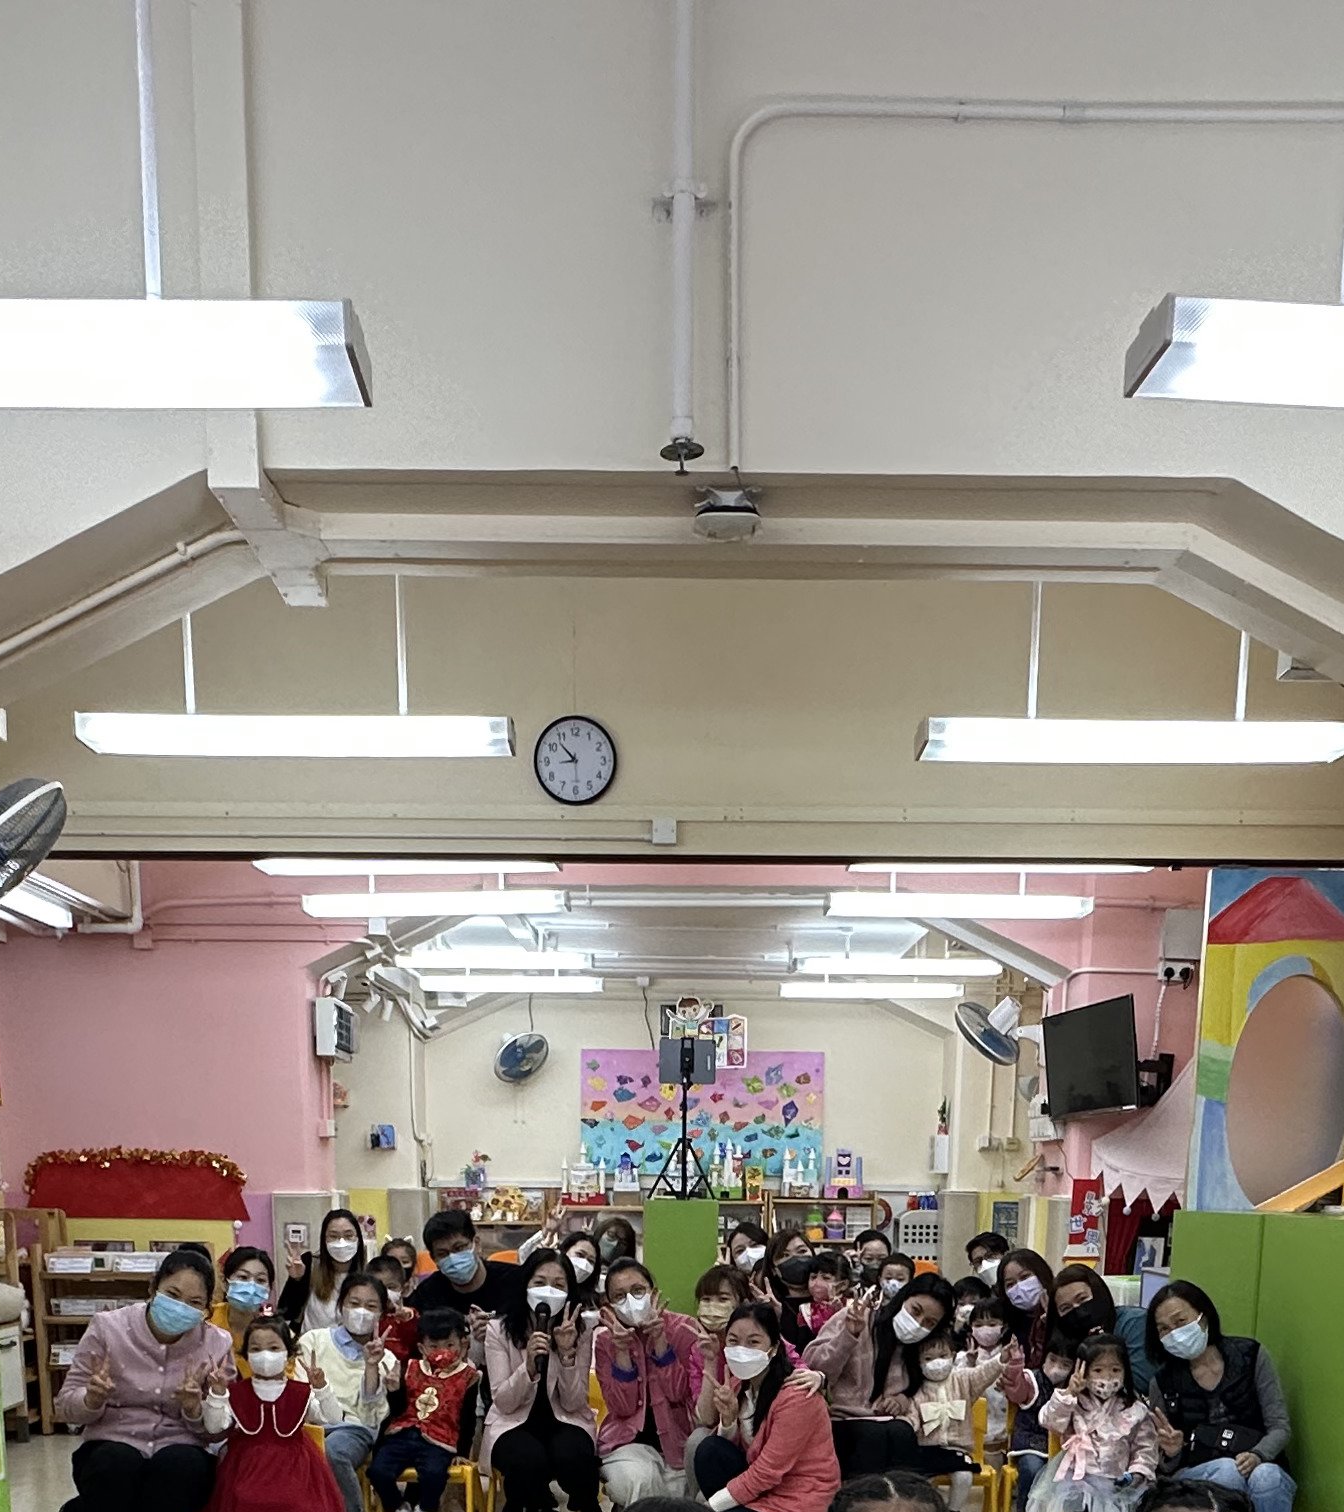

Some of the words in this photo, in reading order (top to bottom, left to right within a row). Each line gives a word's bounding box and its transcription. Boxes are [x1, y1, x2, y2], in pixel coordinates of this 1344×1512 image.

[571, 727, 580, 737] 12
[586, 732, 592, 741] 1
[548, 742, 558, 752] 10
[595, 742, 603, 751] 2
[544, 756, 550, 767] 9
[600, 756, 606, 766] 3
[548, 771, 555, 782] 8
[596, 771, 602, 780] 4
[560, 781, 566, 791] 7
[572, 785, 579, 795] 6
[586, 780, 593, 791] 5
